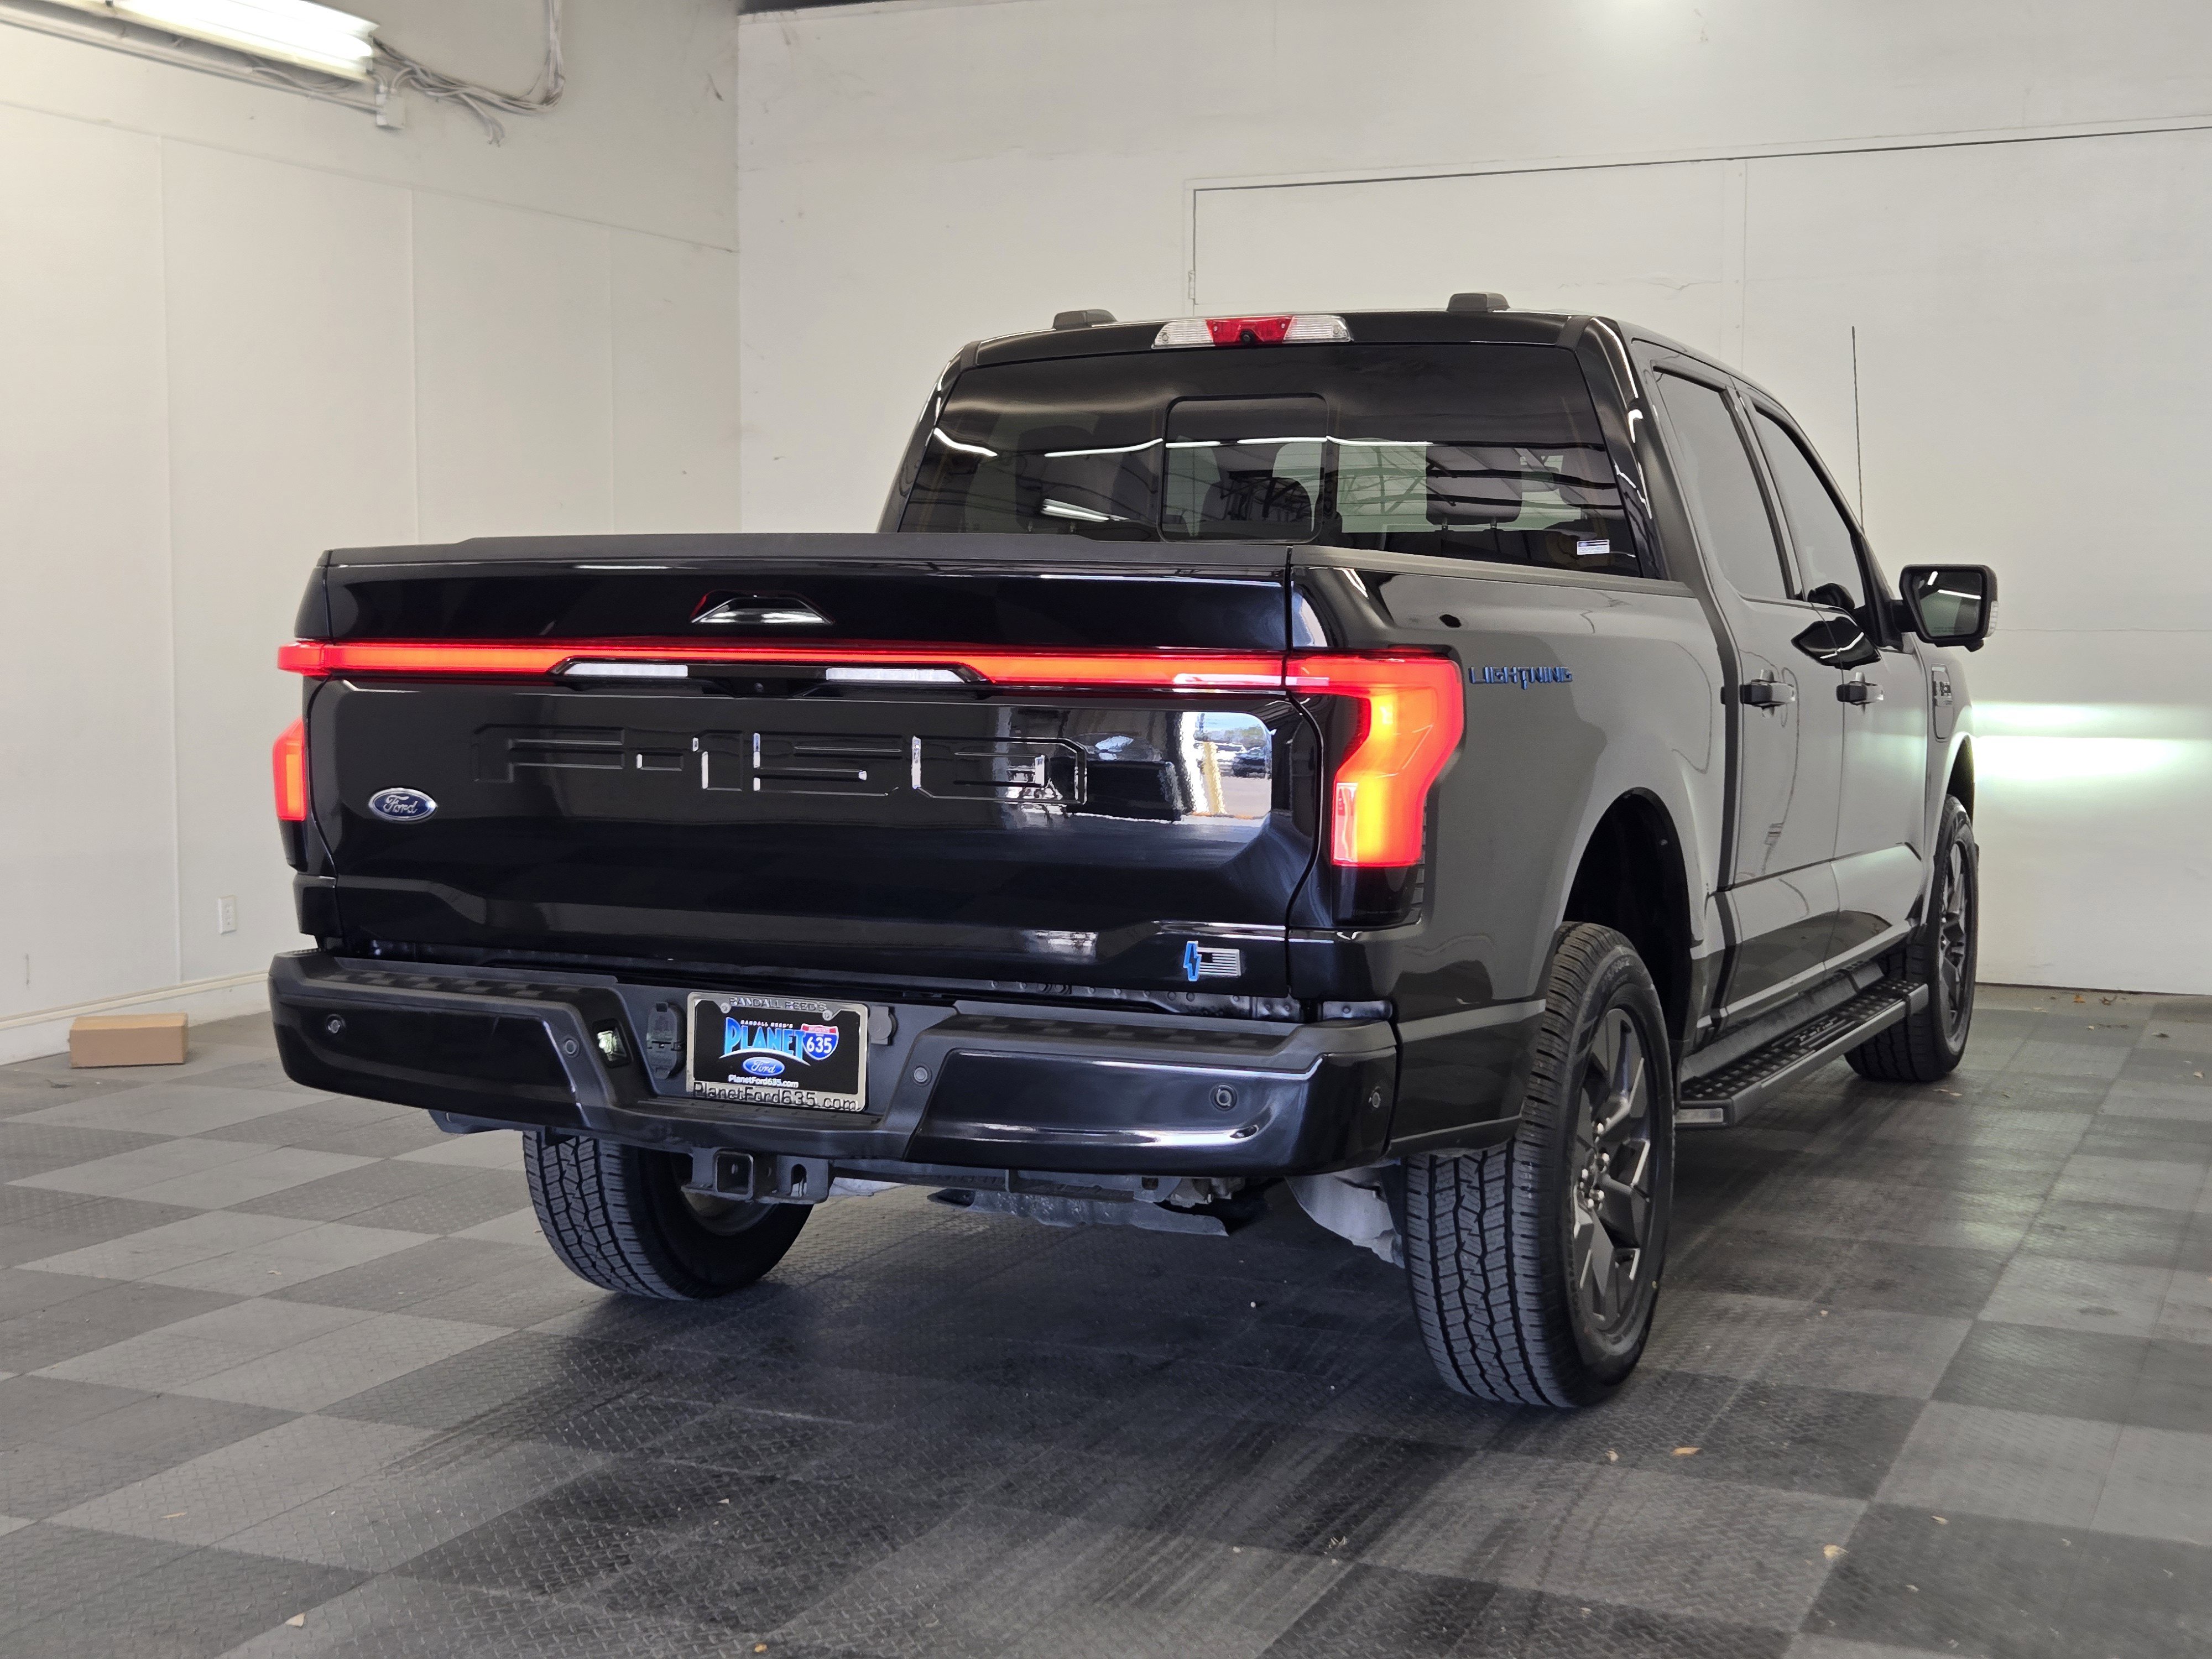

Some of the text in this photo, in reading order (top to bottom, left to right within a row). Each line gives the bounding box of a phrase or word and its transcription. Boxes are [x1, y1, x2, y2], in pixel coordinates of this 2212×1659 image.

[1468, 666, 1573, 690] LIGHTNING
[383, 795, 419, 814] Ford
[729, 997, 827, 1012] RANDALL REED'S
[724, 1016, 832, 1061] PLANET 635
[750, 1058, 776, 1074] Ford
[728, 1074, 799, 1089] PlanetFord635.com
[692, 1082, 858, 1112] PlanetFord635.com
